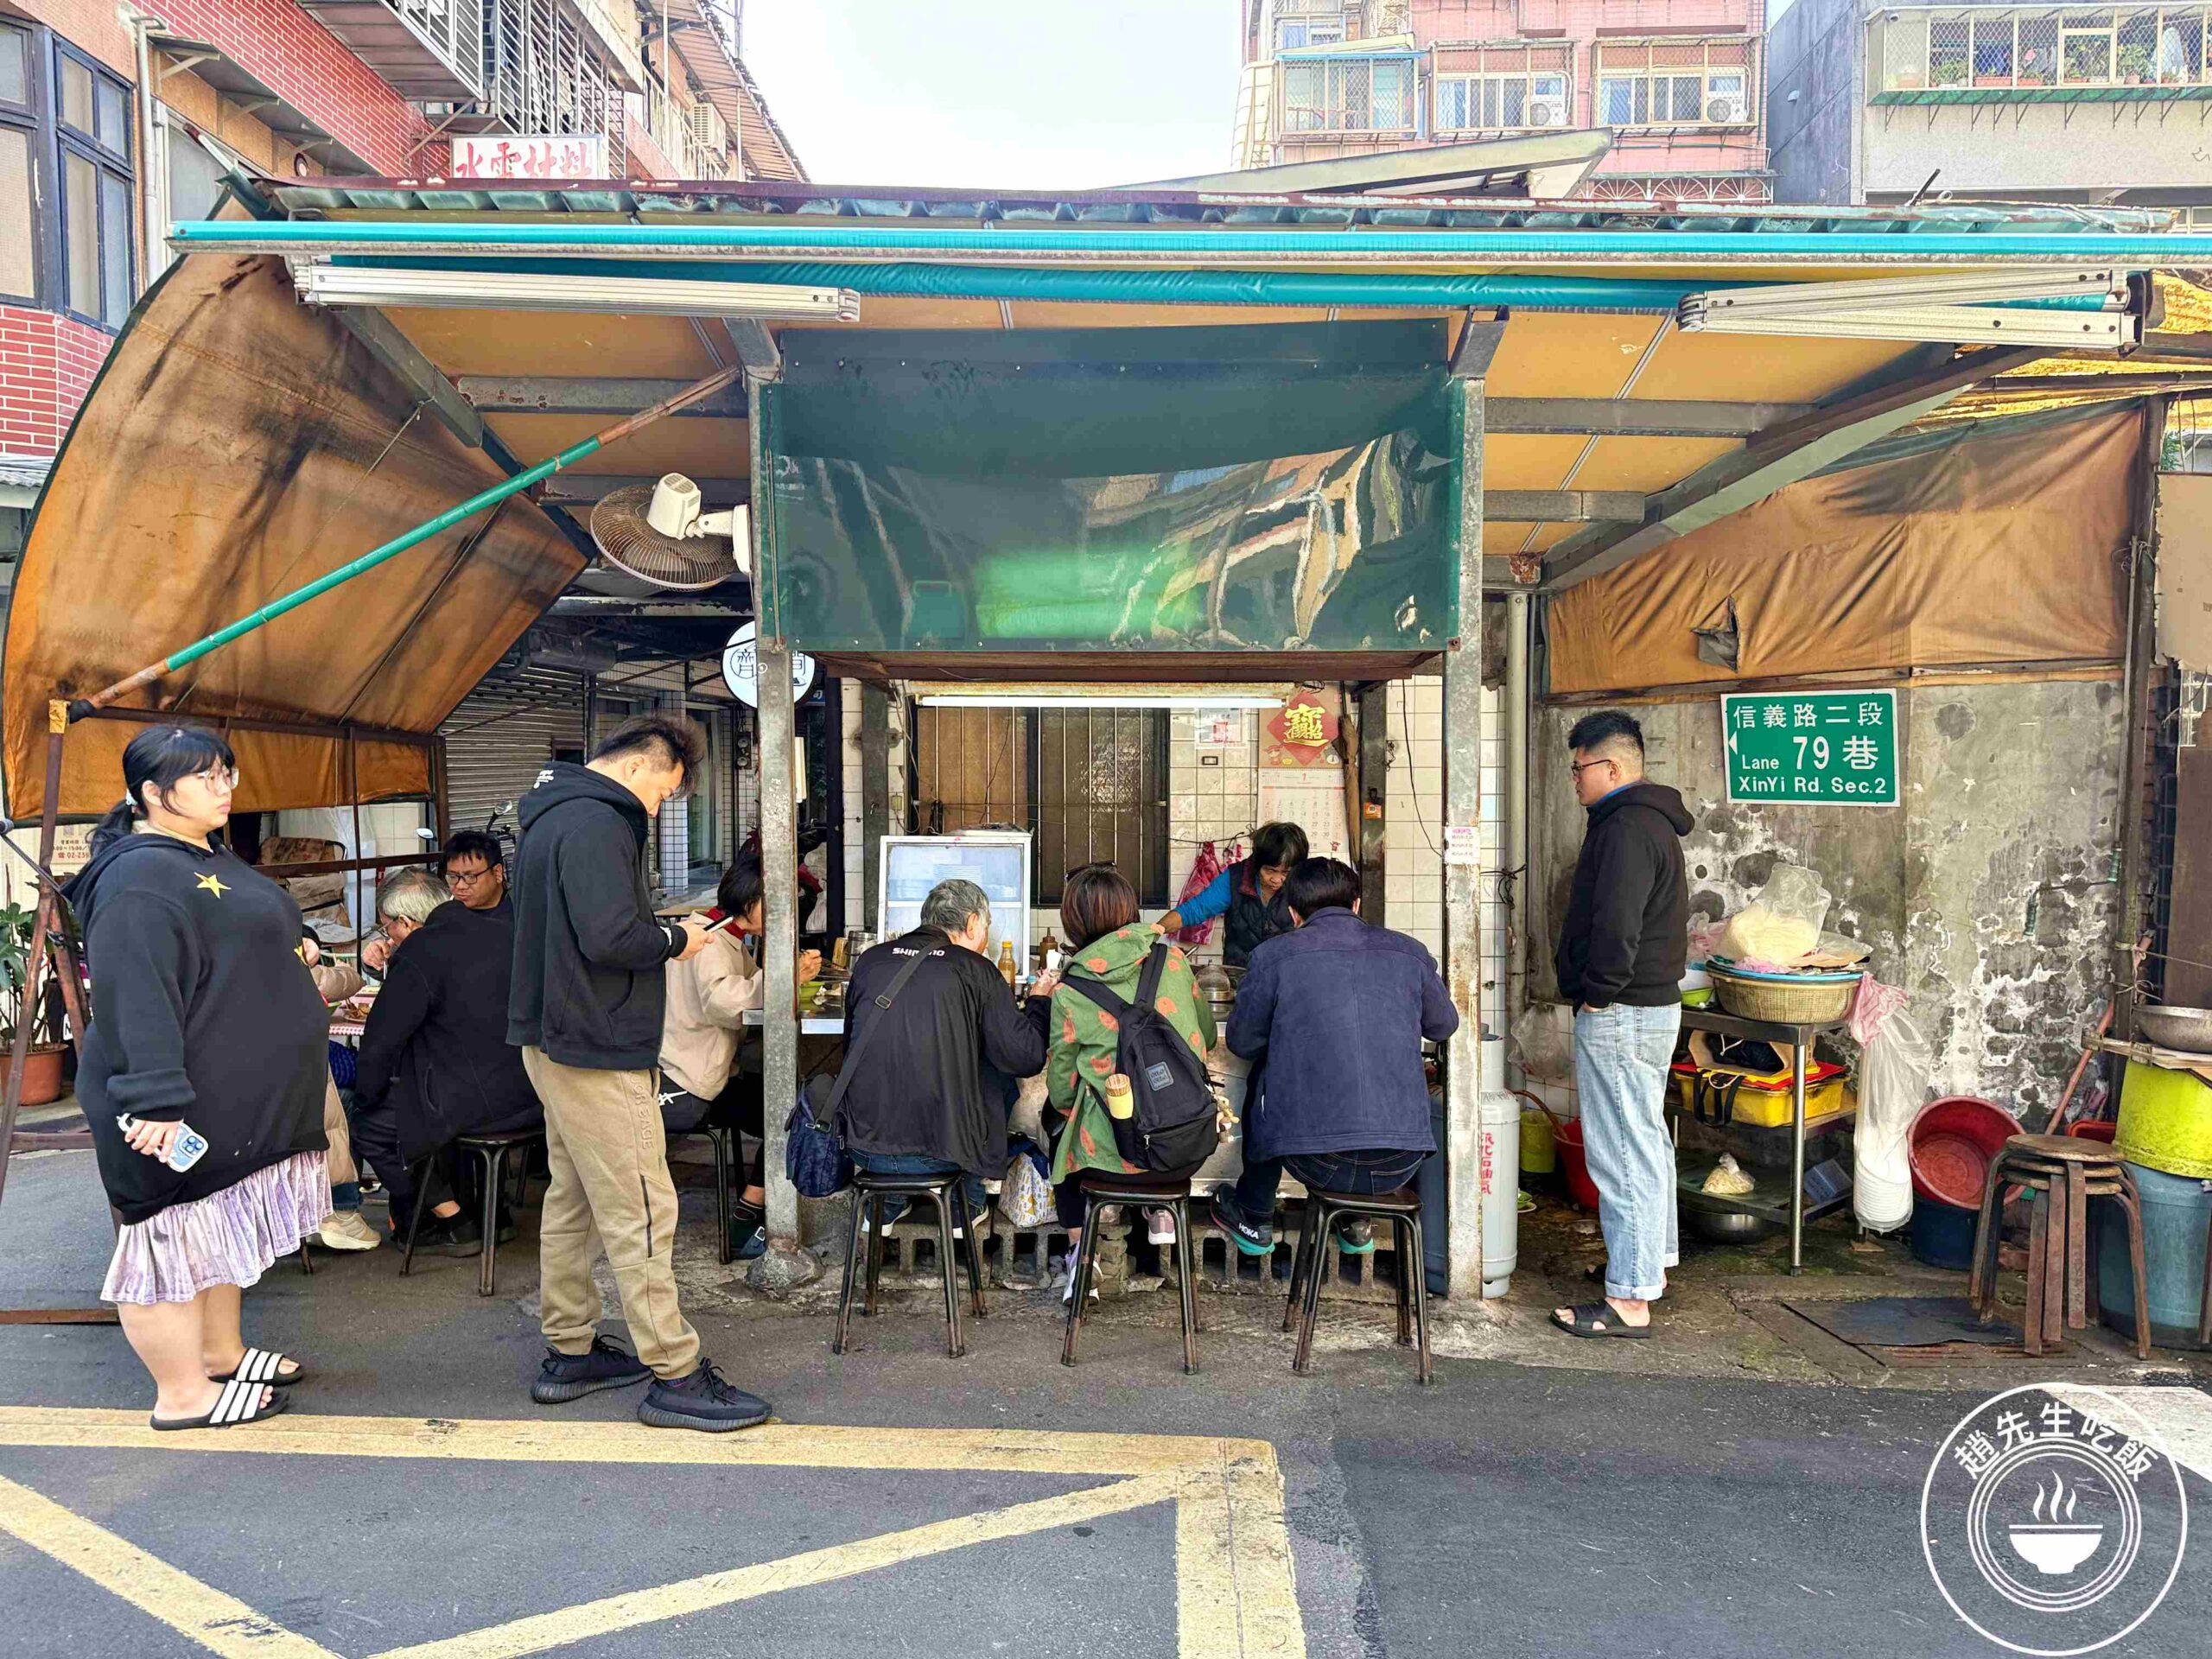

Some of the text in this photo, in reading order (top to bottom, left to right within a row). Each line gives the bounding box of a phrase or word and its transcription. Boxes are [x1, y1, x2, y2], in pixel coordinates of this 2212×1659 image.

[1733, 702, 1884, 728] 信義路二段
[1742, 735, 1878, 770] Lane 79 巷
[1738, 776, 1886, 794] XinYi Rd. Sec.2
[892, 948, 945, 957] SHINO
[1238, 1222, 1259, 1240] HOKA
